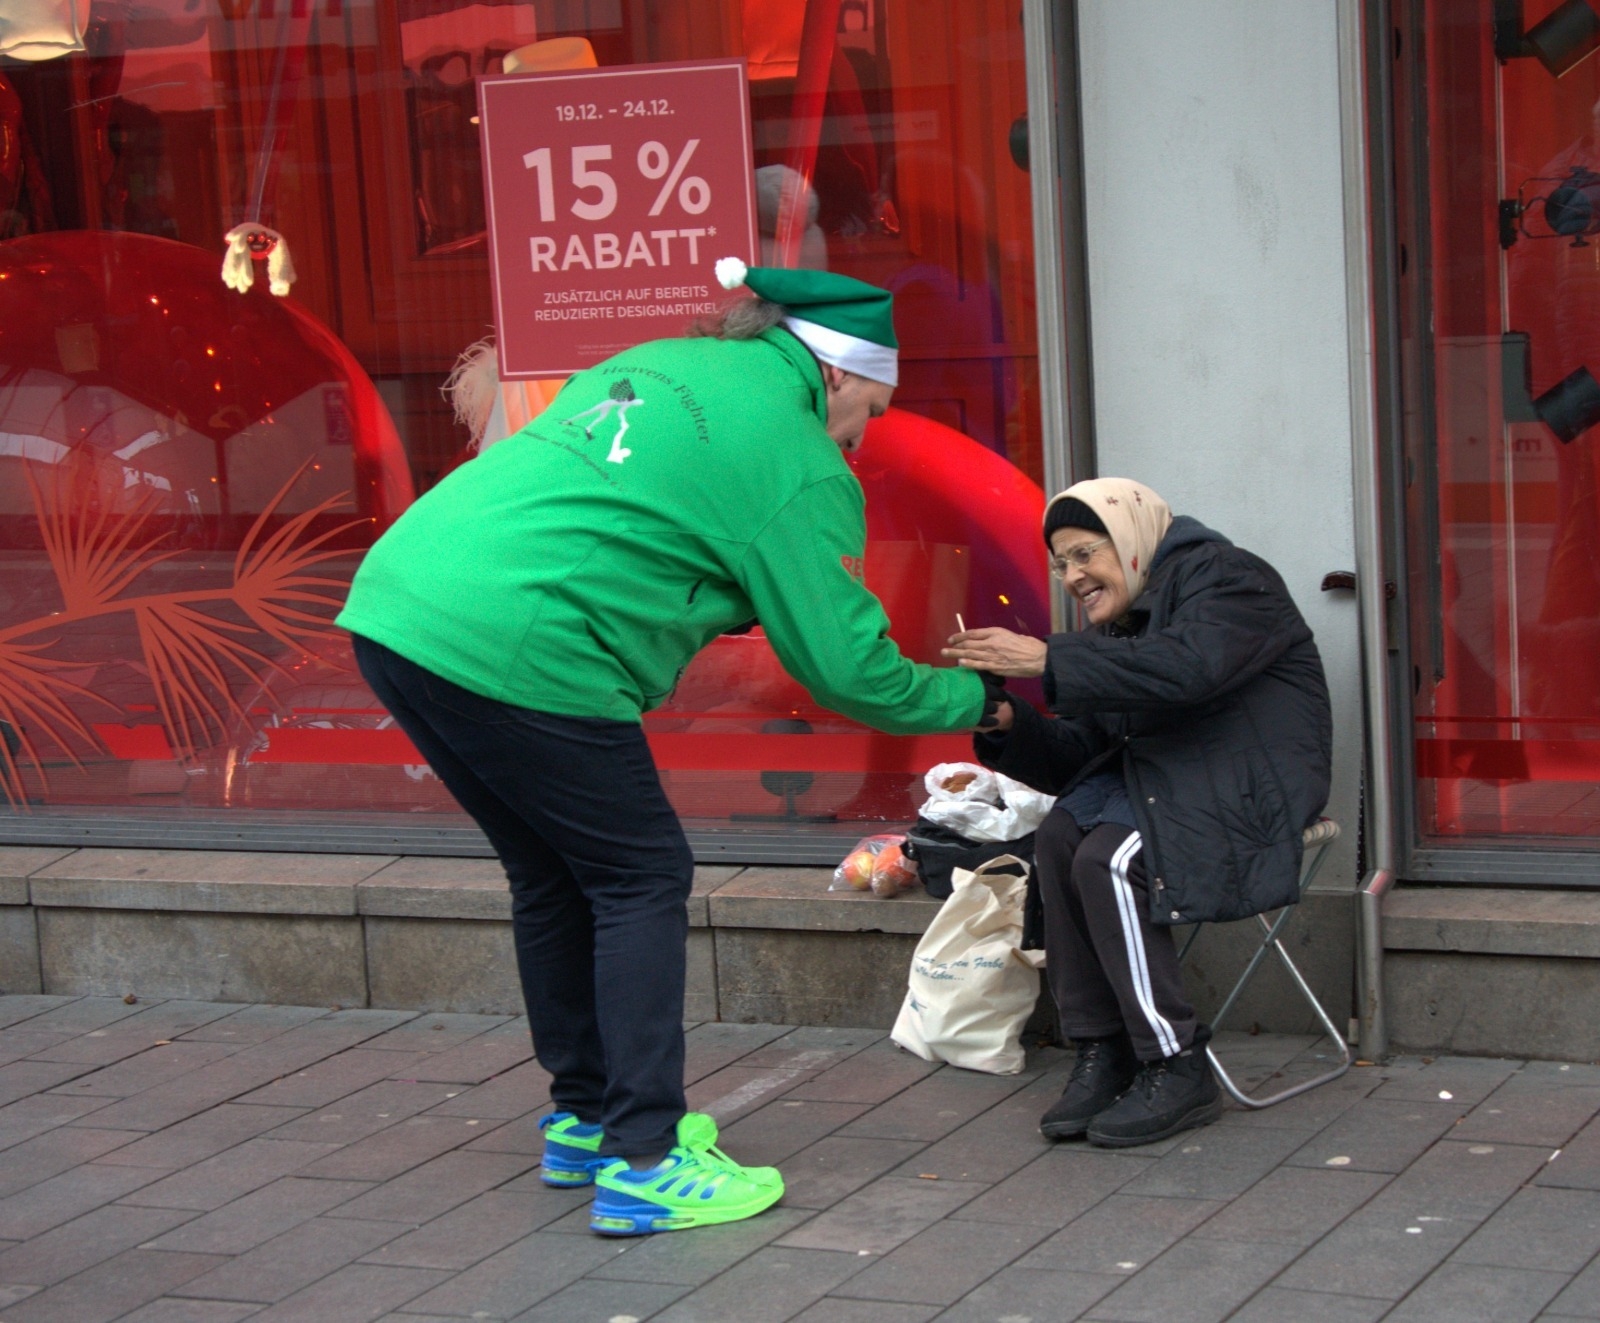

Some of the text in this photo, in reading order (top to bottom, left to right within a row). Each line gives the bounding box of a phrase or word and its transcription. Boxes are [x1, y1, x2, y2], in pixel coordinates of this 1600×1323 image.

[555, 104, 603, 122] 19.12.
[623, 99, 675, 118] 24.12.
[522, 139, 712, 223] 15 %
[544, 285, 709, 305] ZUSÄTZLICH AUF BEREITS
[534, 302, 720, 322] REDUZIERTE DESIGNARTIKEL
[602, 366, 710, 445] Heavens Fighter
[972, 957, 1005, 970] Farbe
